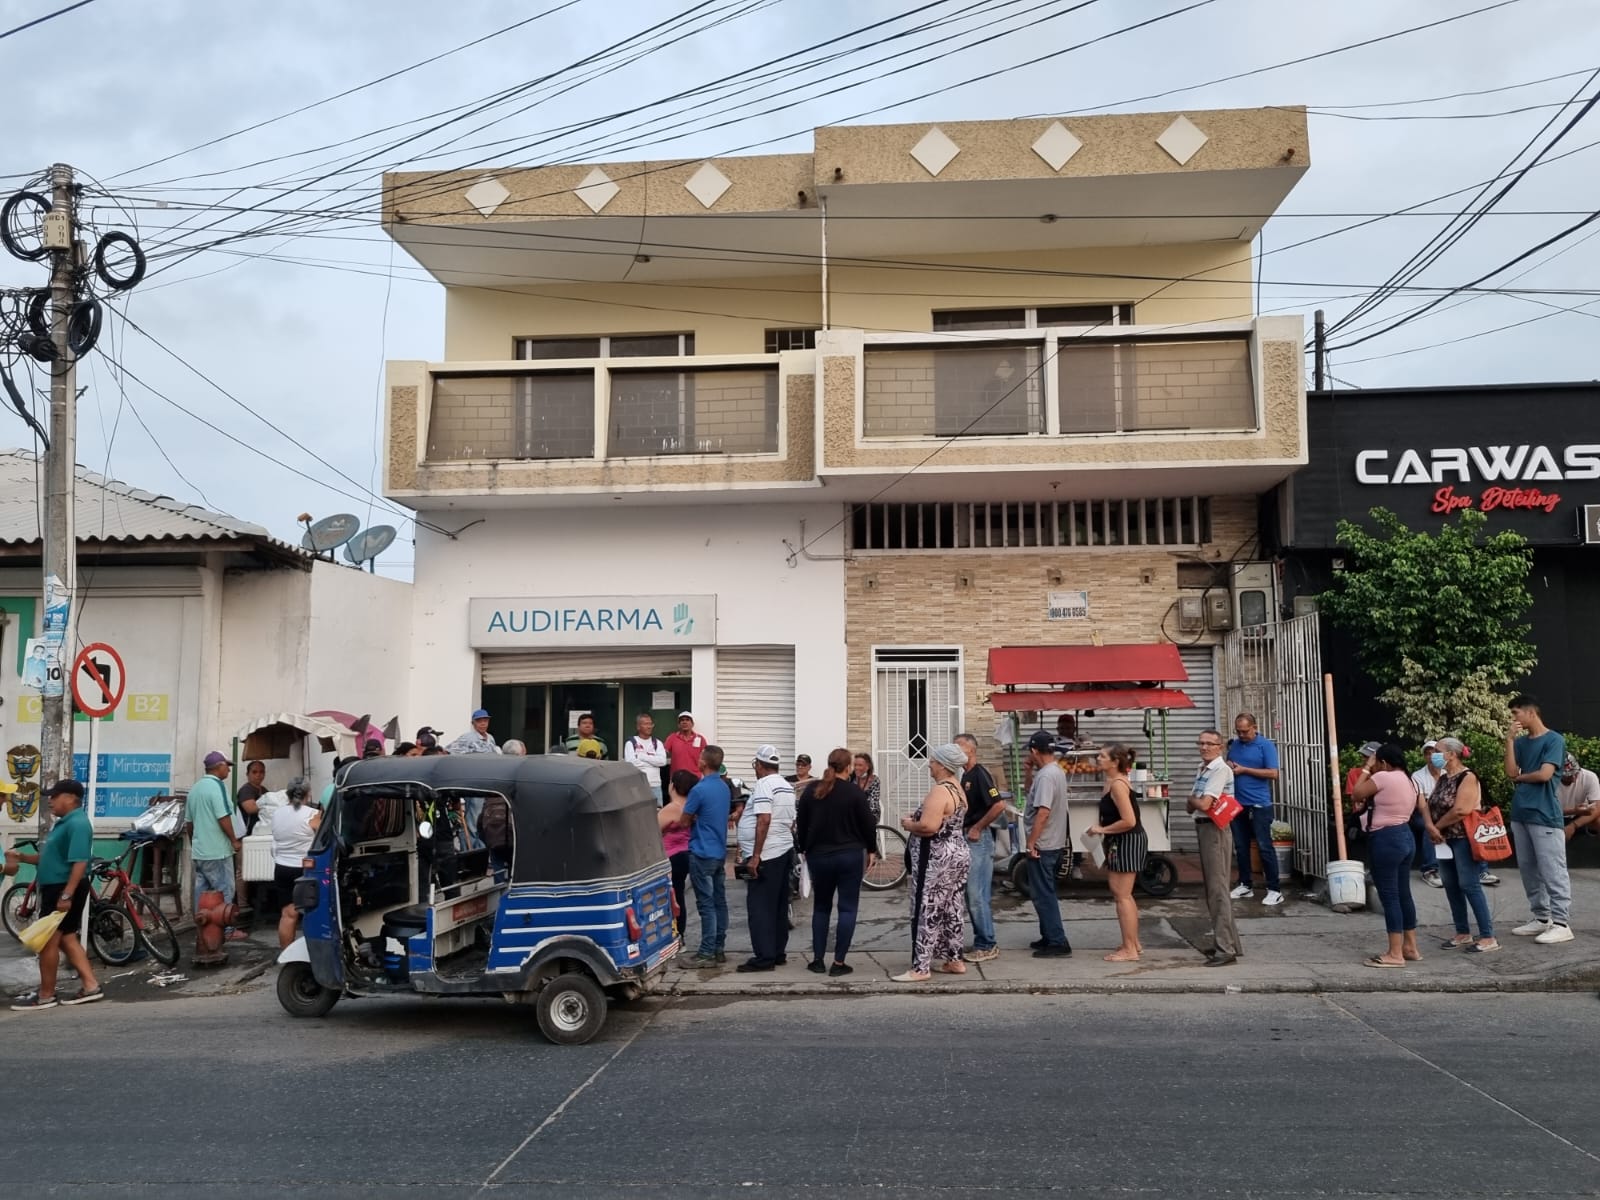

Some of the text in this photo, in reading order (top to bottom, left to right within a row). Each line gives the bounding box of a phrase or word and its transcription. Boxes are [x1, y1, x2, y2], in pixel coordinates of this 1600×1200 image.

[1355, 444, 1600, 485] CARWAS
[1431, 485, 1473, 514] Spa
[487, 608, 663, 633] AUDIFARMA
[46, 667, 61, 681] 10
[135, 695, 161, 713] B2
